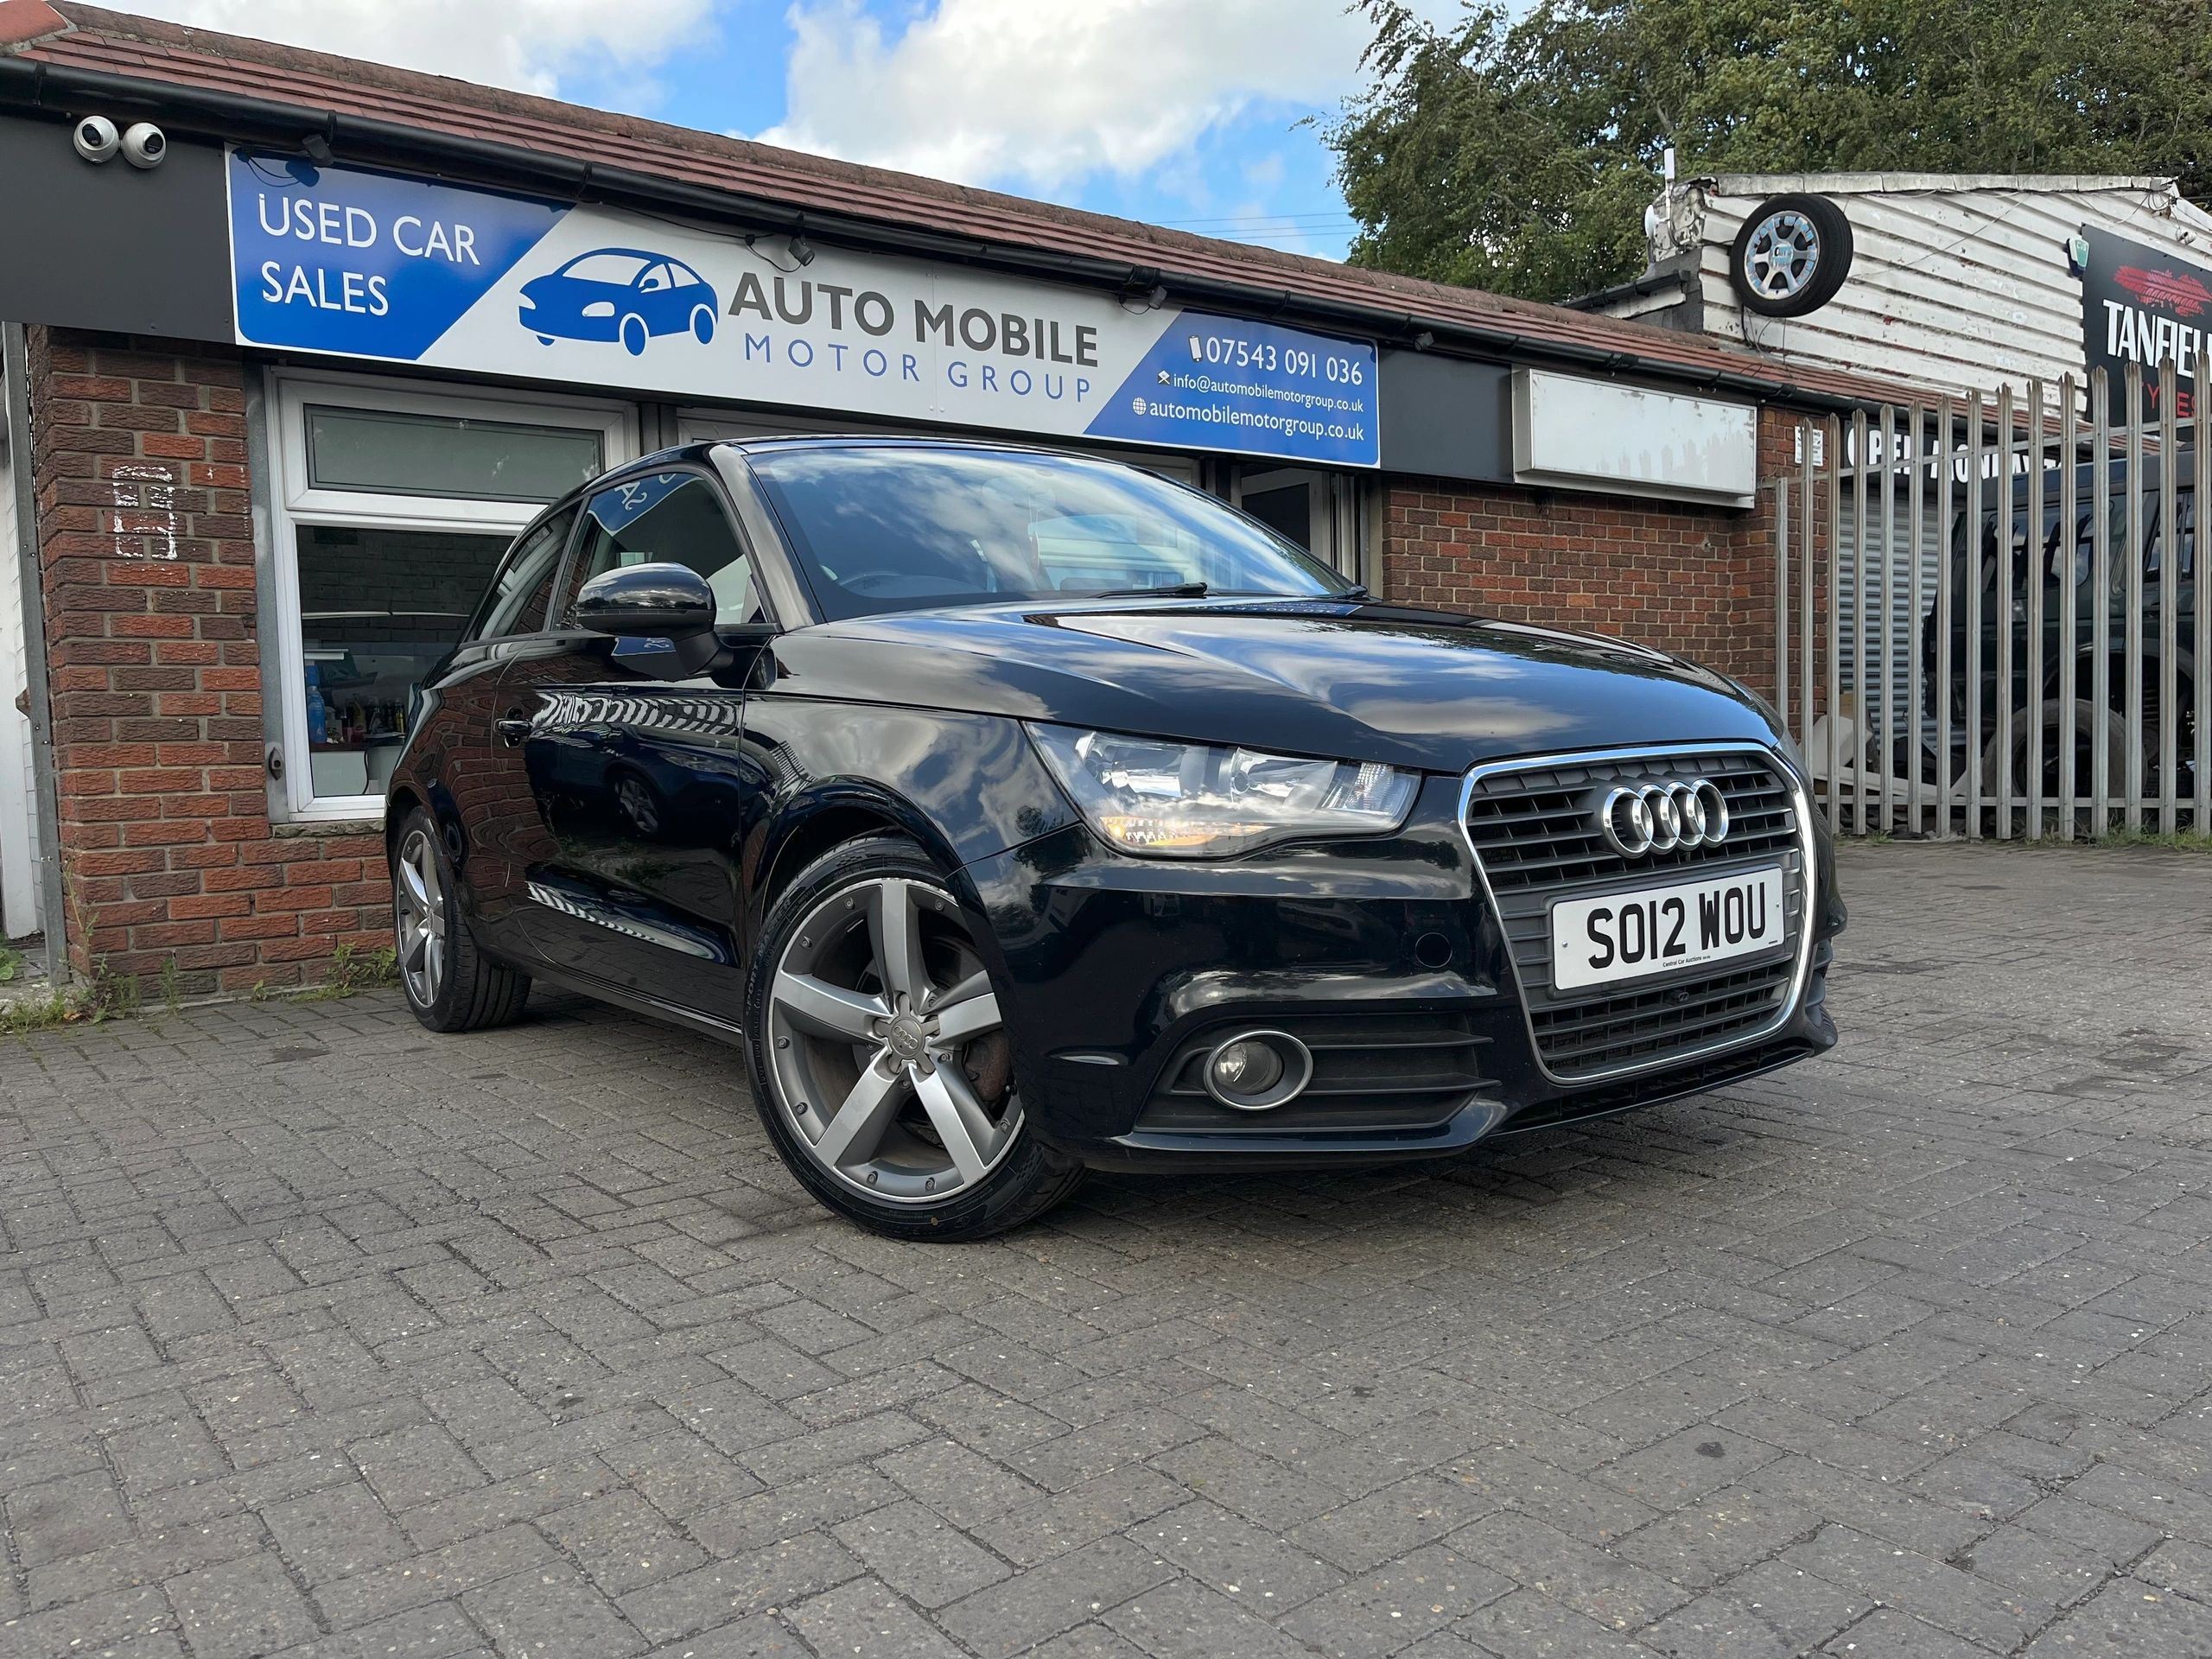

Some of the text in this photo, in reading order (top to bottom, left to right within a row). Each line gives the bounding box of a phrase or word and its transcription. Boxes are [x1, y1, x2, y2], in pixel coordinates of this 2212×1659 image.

[258, 193, 480, 265] USED CAR
[261, 260, 389, 316] SALES
[728, 271, 1098, 367] AUTO MOBILE
[745, 332, 1090, 402] MOTOR GROUP
[1205, 336, 1363, 385] 07543 091 036
[2102, 298, 2212, 384] TANFIEL
[1149, 400, 1364, 442] automobilemotorgroup.co.uk
[1173, 373, 1363, 413] info@automobilemotorgroup.co.uk
[1586, 881, 1765, 969] SO12 WOU
